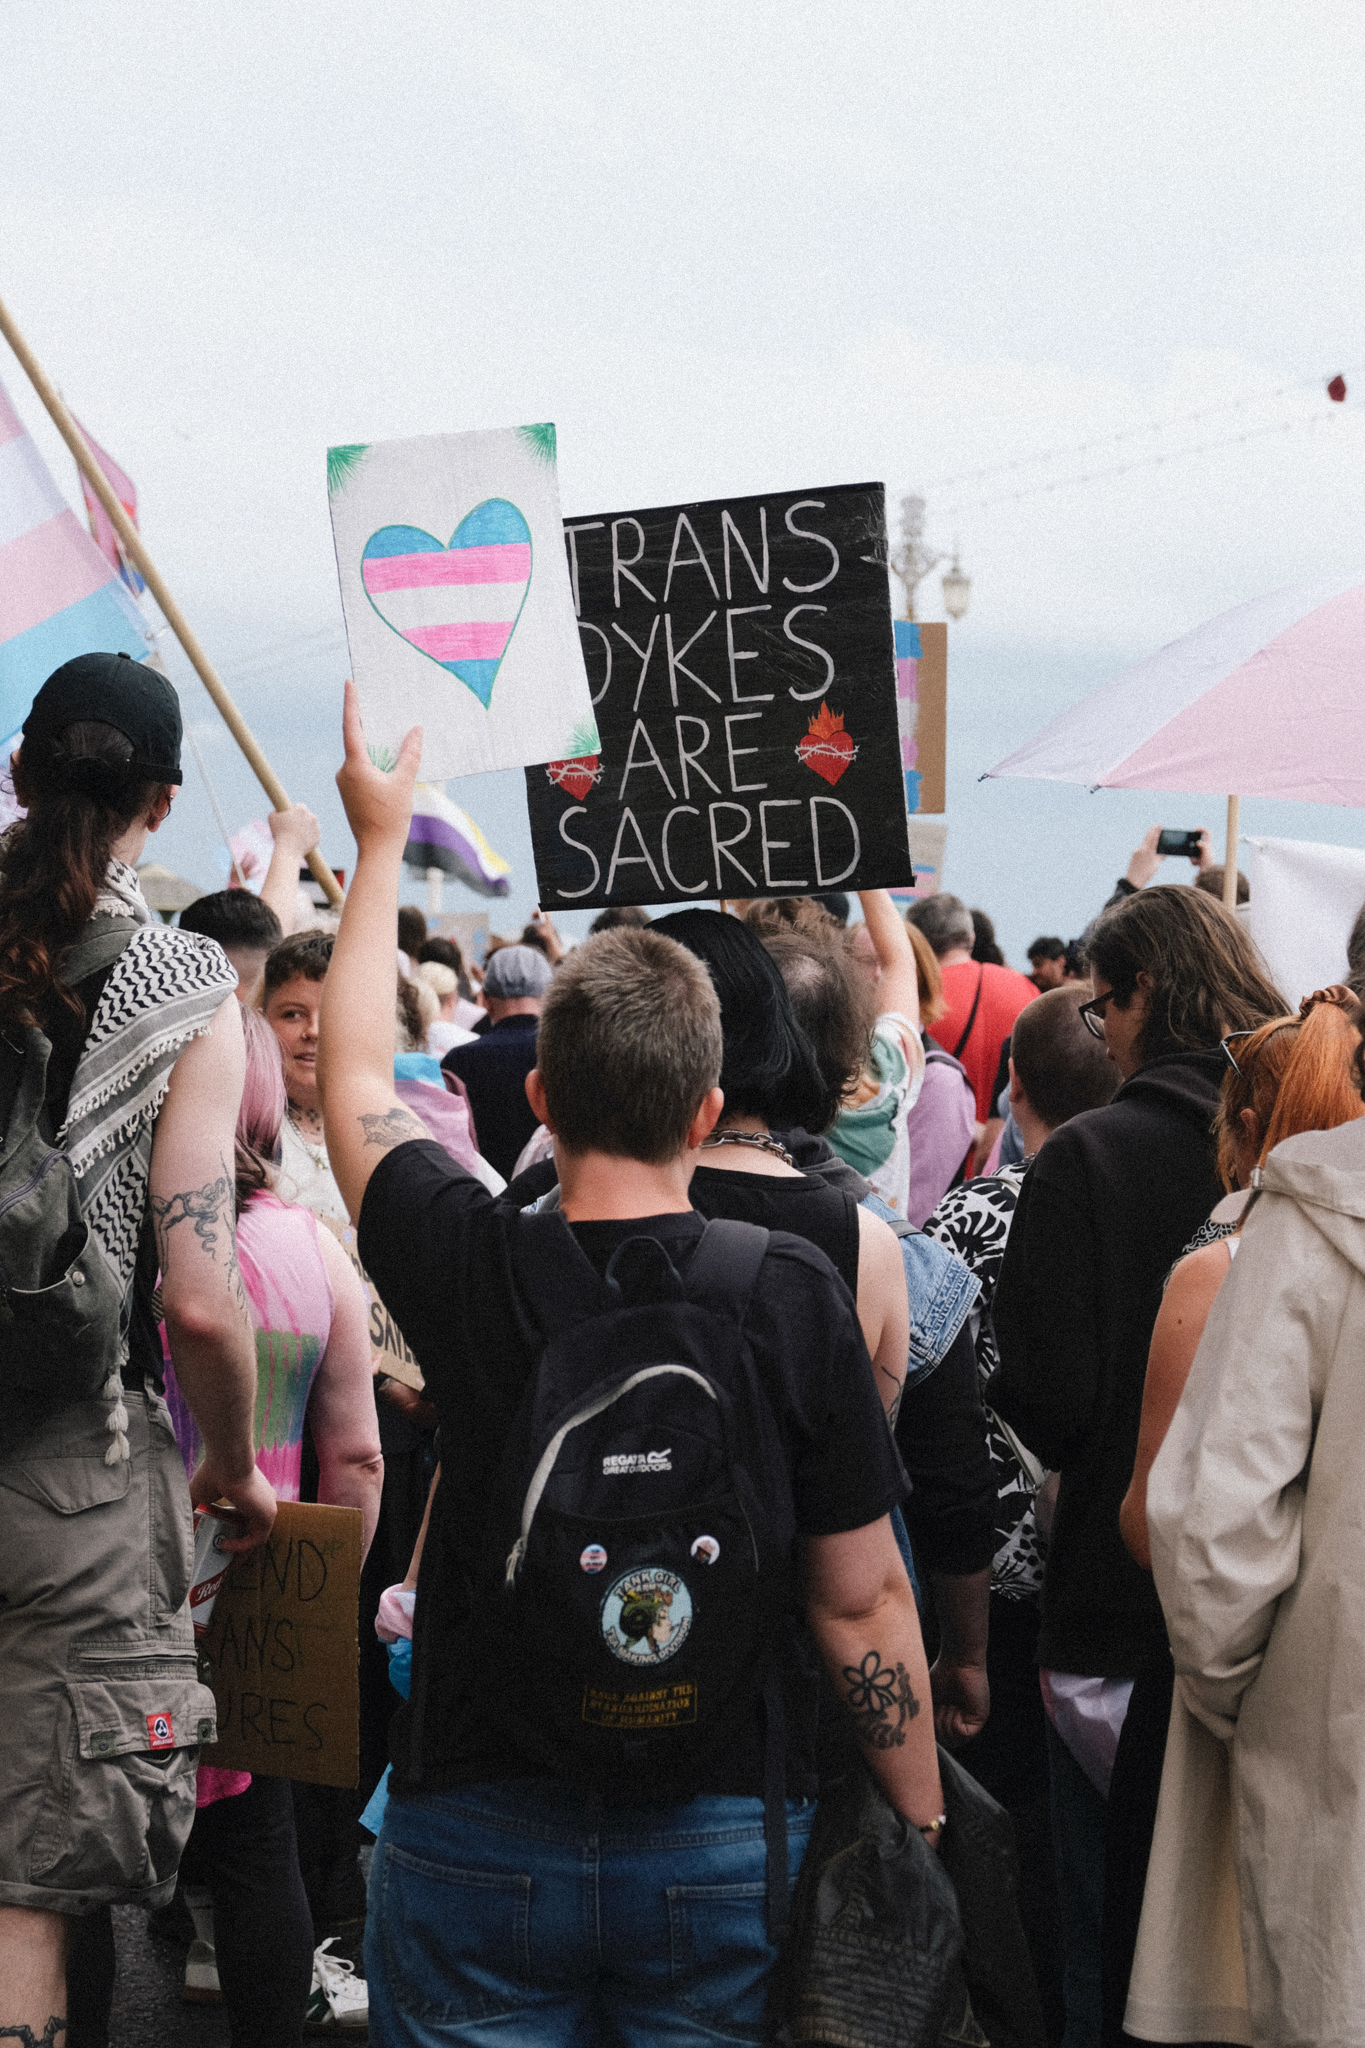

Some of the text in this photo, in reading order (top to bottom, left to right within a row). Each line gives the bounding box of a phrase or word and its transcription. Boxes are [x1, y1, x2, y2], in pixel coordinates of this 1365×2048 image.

[563, 500, 839, 616] TRANS
[619, 713, 767, 799] ARE
[557, 796, 860, 898] SACRED
[615, 1572, 682, 1597] TANK GIRL
